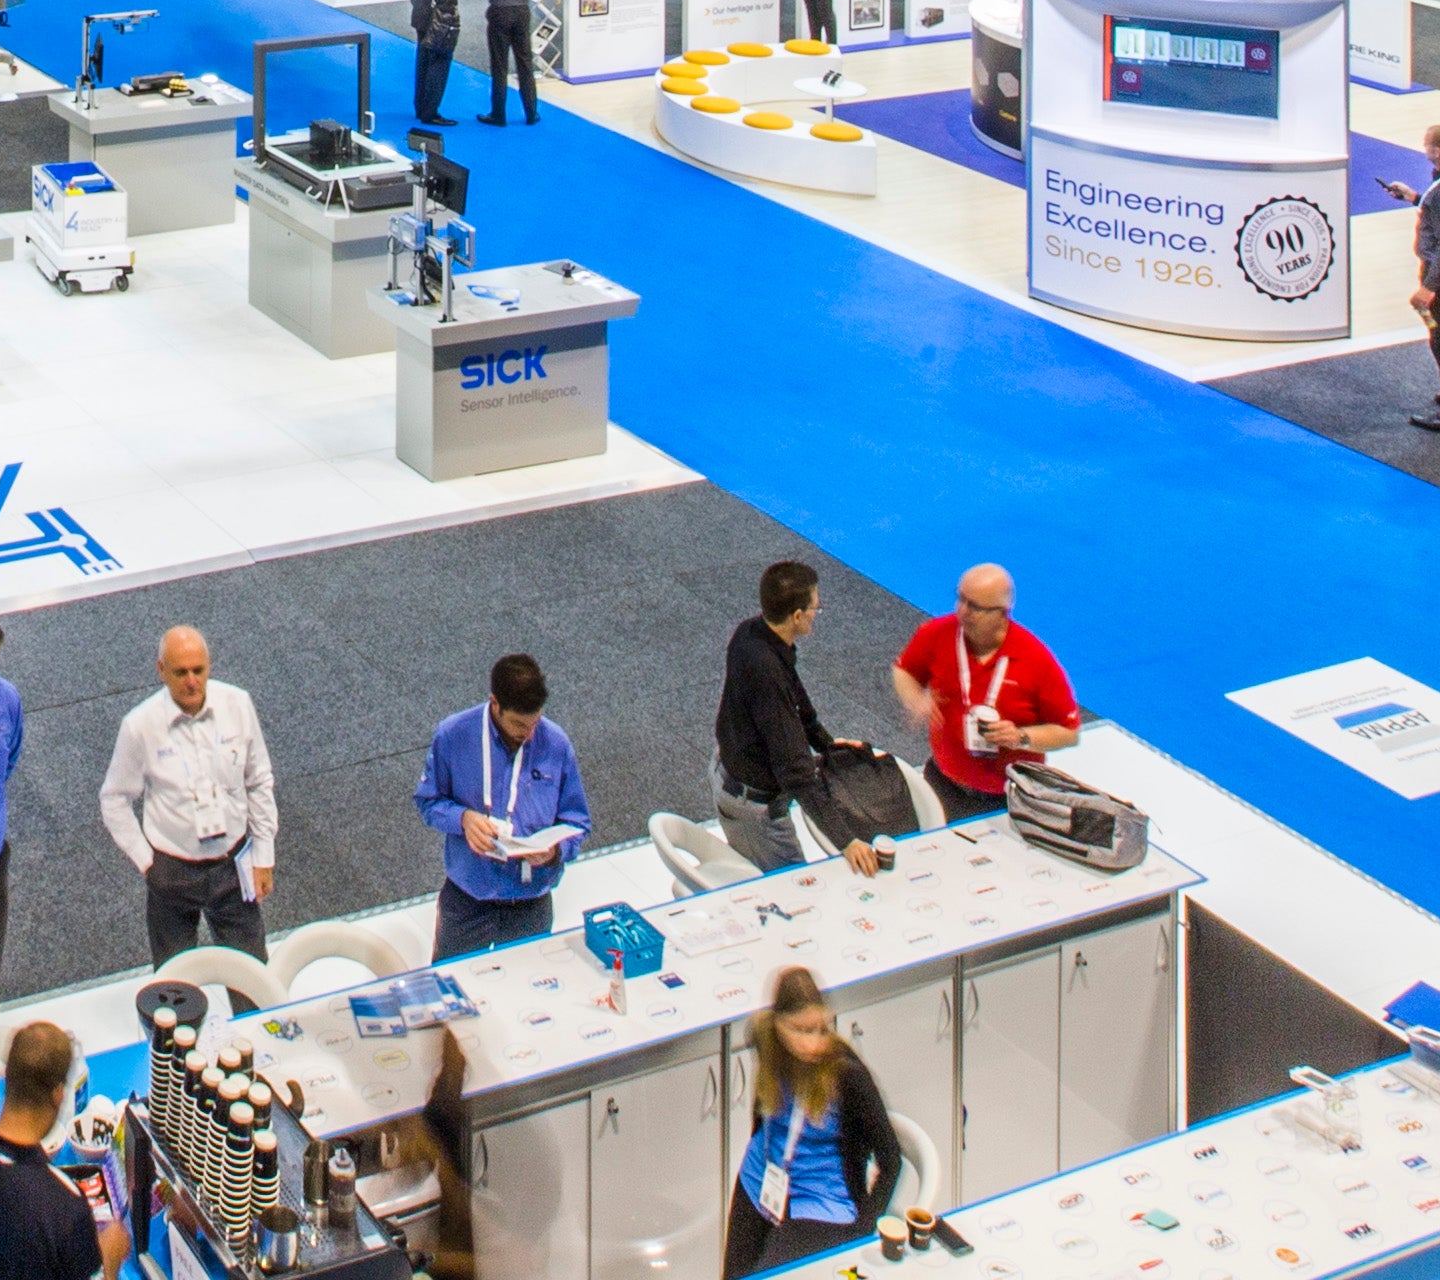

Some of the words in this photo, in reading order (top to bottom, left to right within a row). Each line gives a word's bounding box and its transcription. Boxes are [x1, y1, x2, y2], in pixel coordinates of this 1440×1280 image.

[727, 3, 753, 15] heritage
[33, 174, 54, 213] SICK
[1045, 169, 1225, 225] Engineering
[1045, 202, 1216, 256] Excellence.
[1265, 223, 1304, 261] 90
[1045, 234, 1122, 274] Since
[1136, 259, 1222, 289] 1926.
[1276, 253, 1312, 275] YEARS
[460, 344, 548, 390] SICK
[460, 393, 504, 414] Sensor
[509, 384, 582, 409] Intelligence.
[1349, 709, 1431, 740] APPMA
